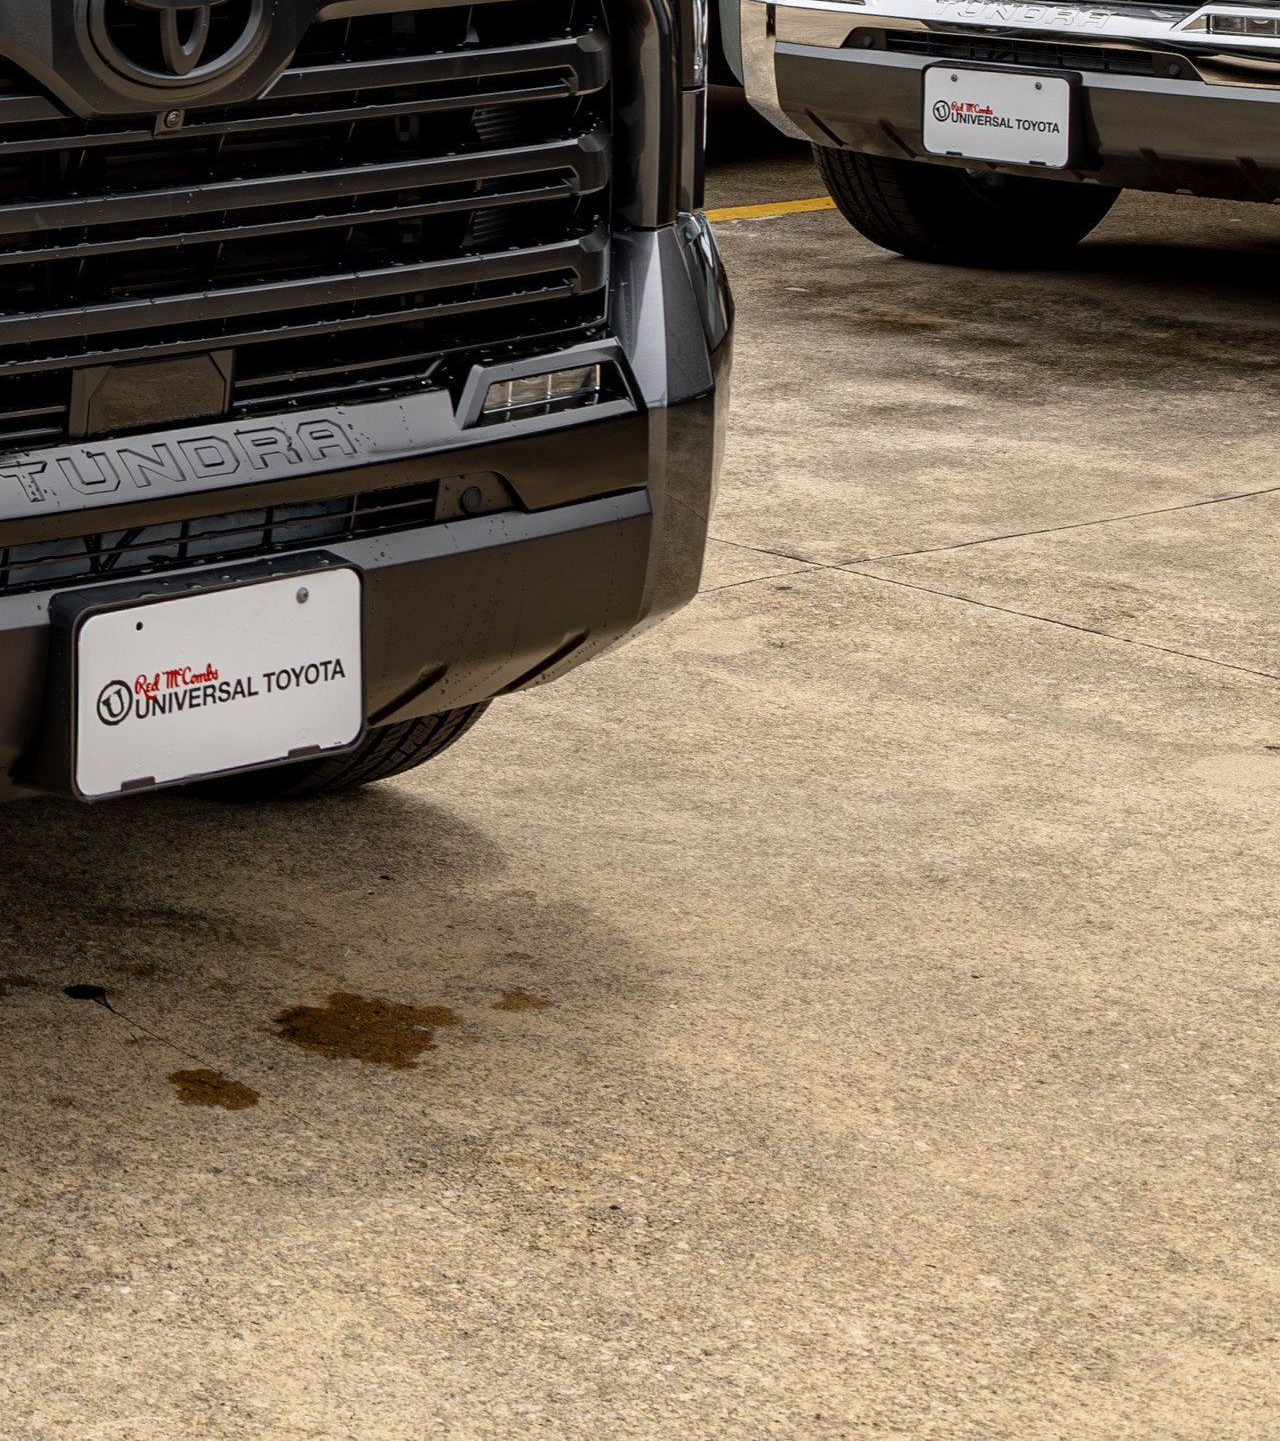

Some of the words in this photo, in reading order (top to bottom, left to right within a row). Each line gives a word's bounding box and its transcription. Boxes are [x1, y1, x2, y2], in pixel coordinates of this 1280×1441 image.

[951, 112, 1014, 129] UNIVERSAL
[1015, 118, 1061, 134] TOYOTA
[134, 672, 160, 701] Red
[161, 662, 219, 689] McCombs
[134, 675, 259, 720] UNIVERSAL
[262, 658, 346, 694] TOYOTA
